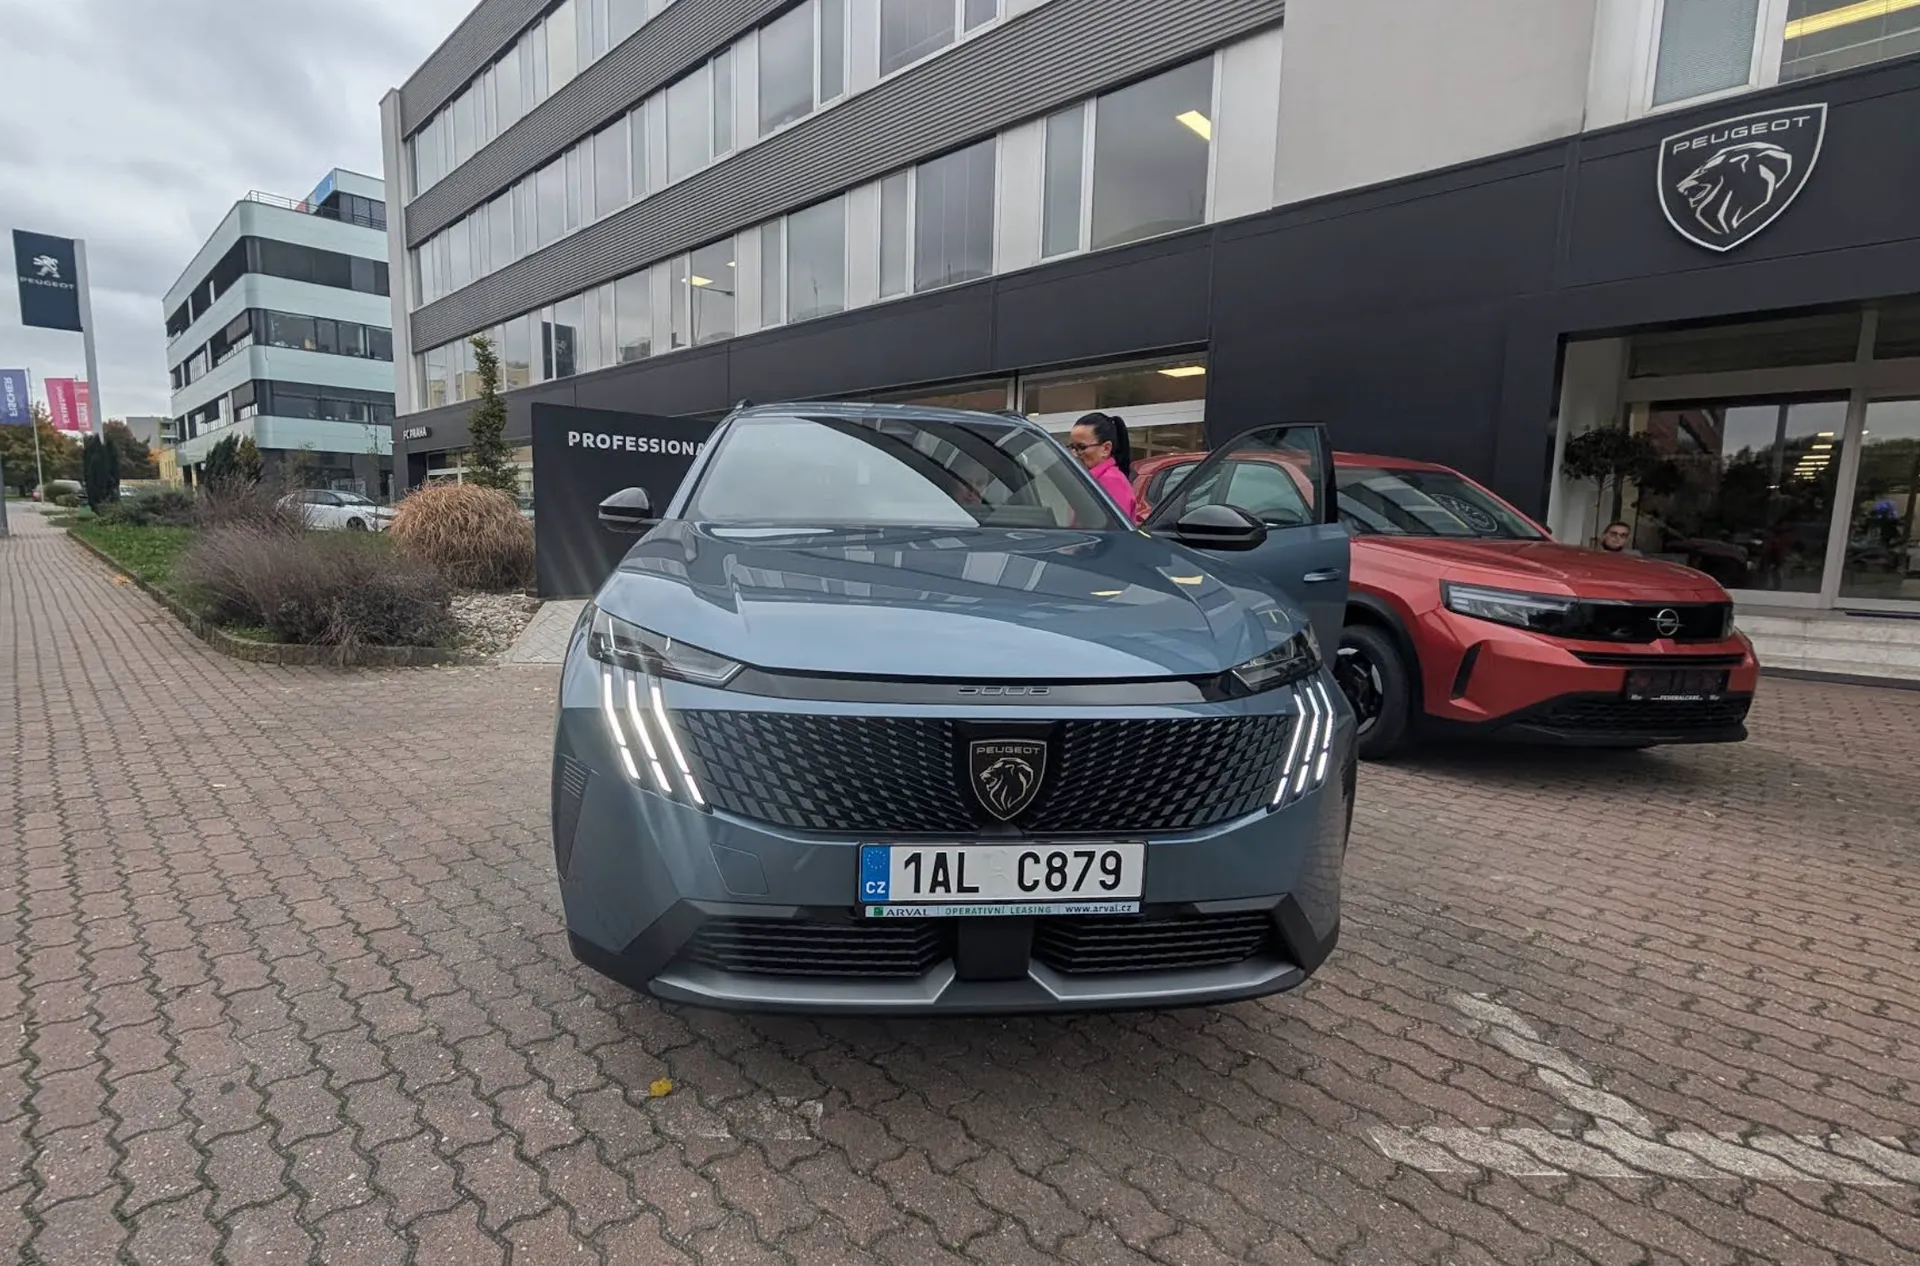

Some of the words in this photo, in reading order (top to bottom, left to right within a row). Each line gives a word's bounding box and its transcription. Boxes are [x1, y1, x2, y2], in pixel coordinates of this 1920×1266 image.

[1672, 115, 1811, 155] PEUGEOT
[19, 276, 75, 290] PEUGEOT
[409, 426, 427, 439] PRAHA
[976, 746, 1040, 755] PEUGEOT
[904, 851, 980, 894] 1AL
[1017, 850, 1122, 893] C879
[865, 881, 886, 894] CZ
[886, 908, 929, 917] ARVAL
[945, 905, 1005, 915] OPERATIVNÍ
[1010, 905, 1051, 915] LEASING
[1065, 903, 1132, 914] www.arval.cz
